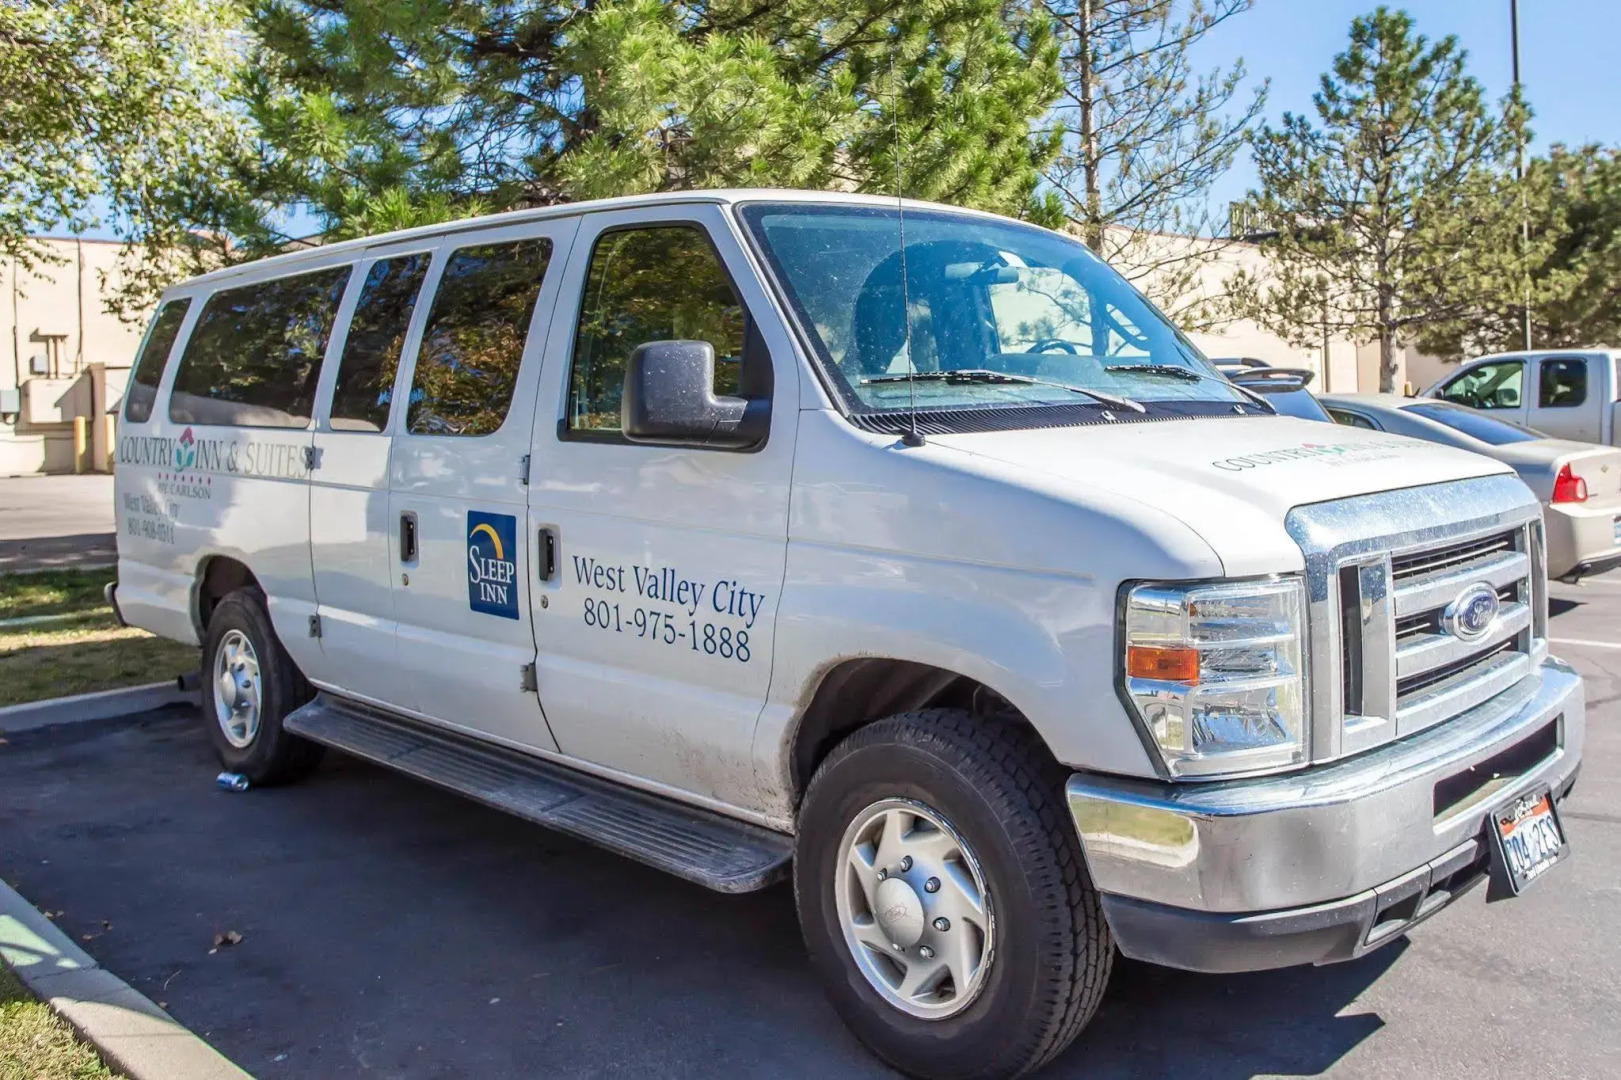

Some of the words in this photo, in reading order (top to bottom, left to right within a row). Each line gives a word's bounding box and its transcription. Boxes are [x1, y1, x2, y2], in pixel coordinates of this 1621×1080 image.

[120, 436, 178, 468] COUNTRY
[195, 438, 225, 472] INN
[226, 442, 240, 472] &
[244, 441, 309, 478] SUITES
[169, 483, 212, 500] CARLSON
[480, 582, 508, 605] INN
[572, 554, 626, 593] West
[632, 564, 706, 616] Valley
[713, 579, 766, 629] City
[583, 597, 752, 663] 801-975-1888
